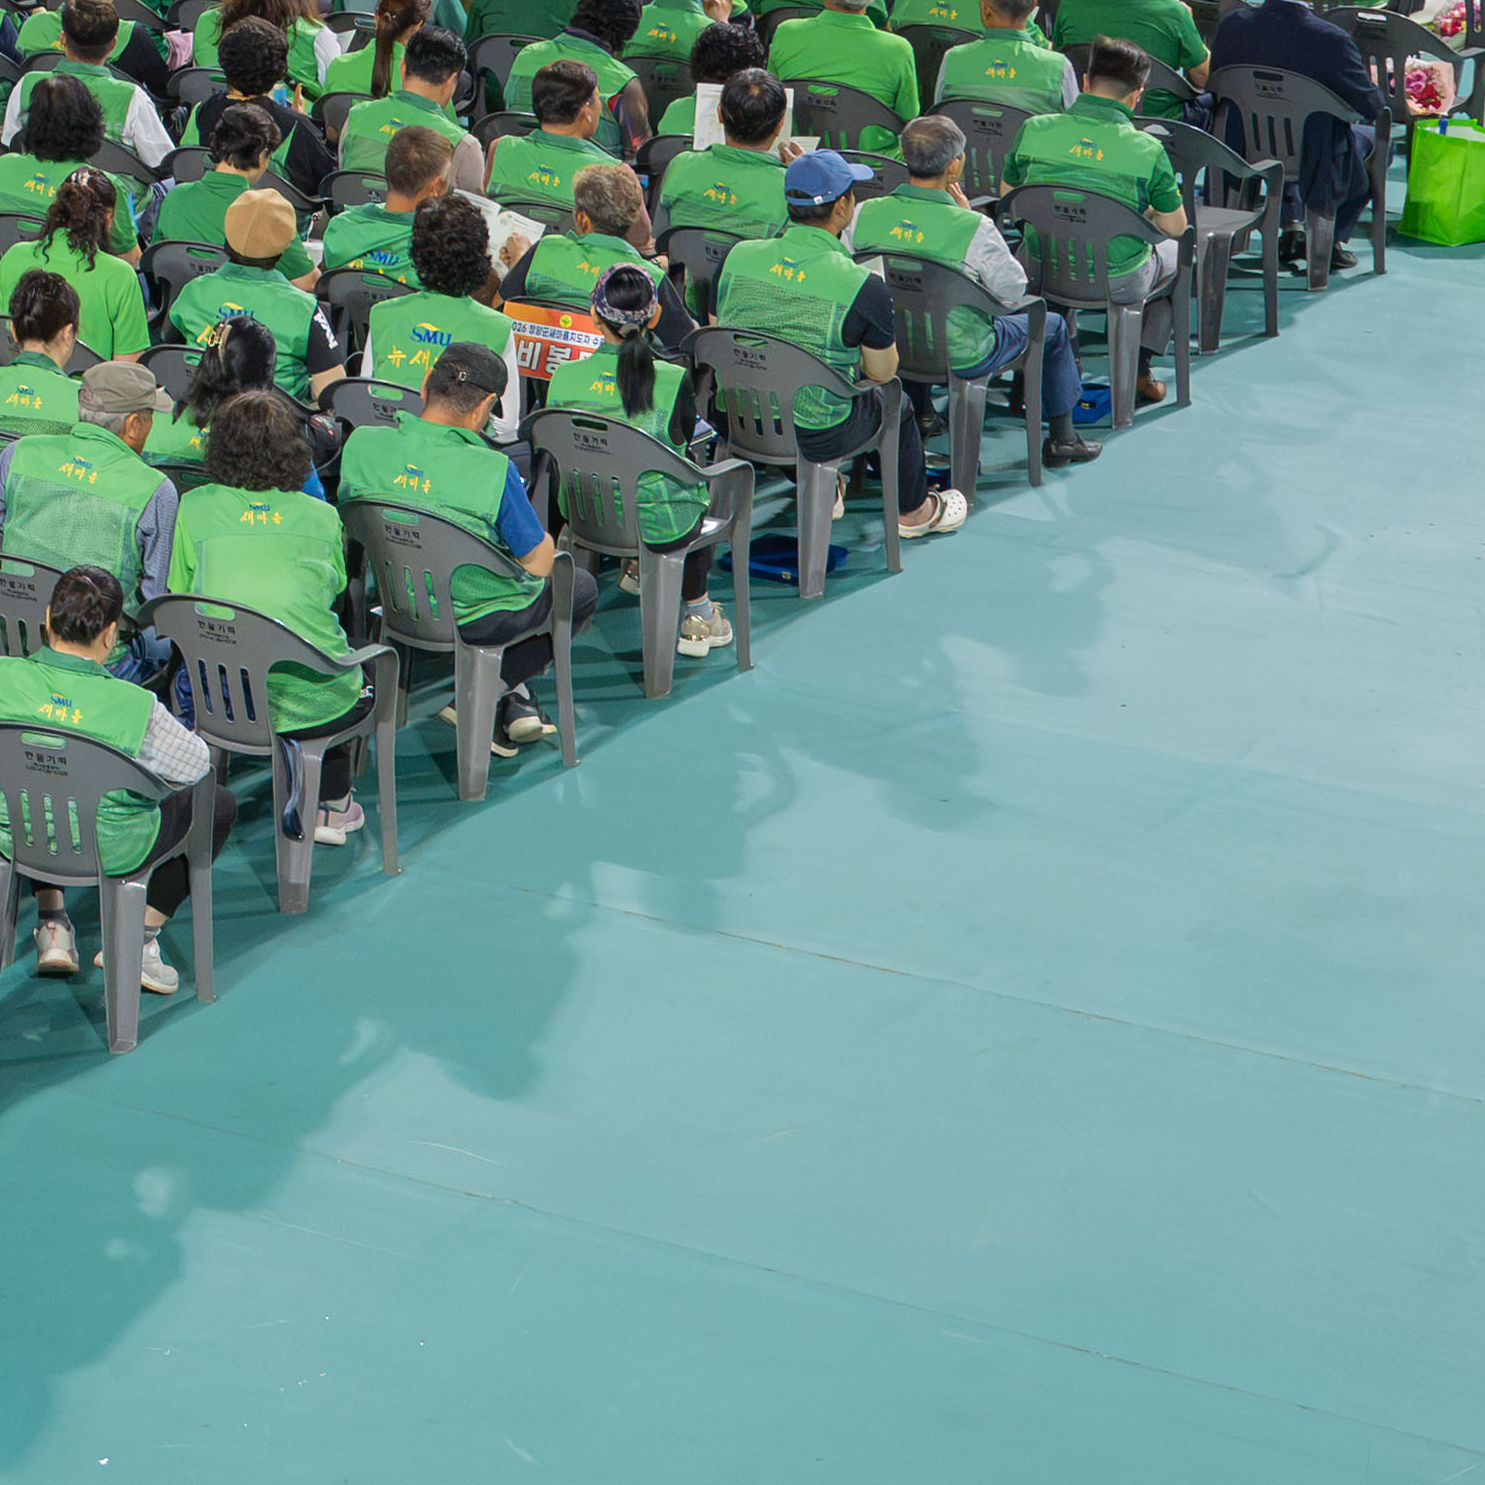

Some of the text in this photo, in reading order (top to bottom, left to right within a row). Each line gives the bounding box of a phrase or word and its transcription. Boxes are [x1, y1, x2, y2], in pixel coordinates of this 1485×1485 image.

[410, 327, 453, 350] SMU
[528, 323, 590, 345] 청양군새마을지도자
[517, 339, 572, 376] 비봉
[37, 703, 83, 725] 새마을
